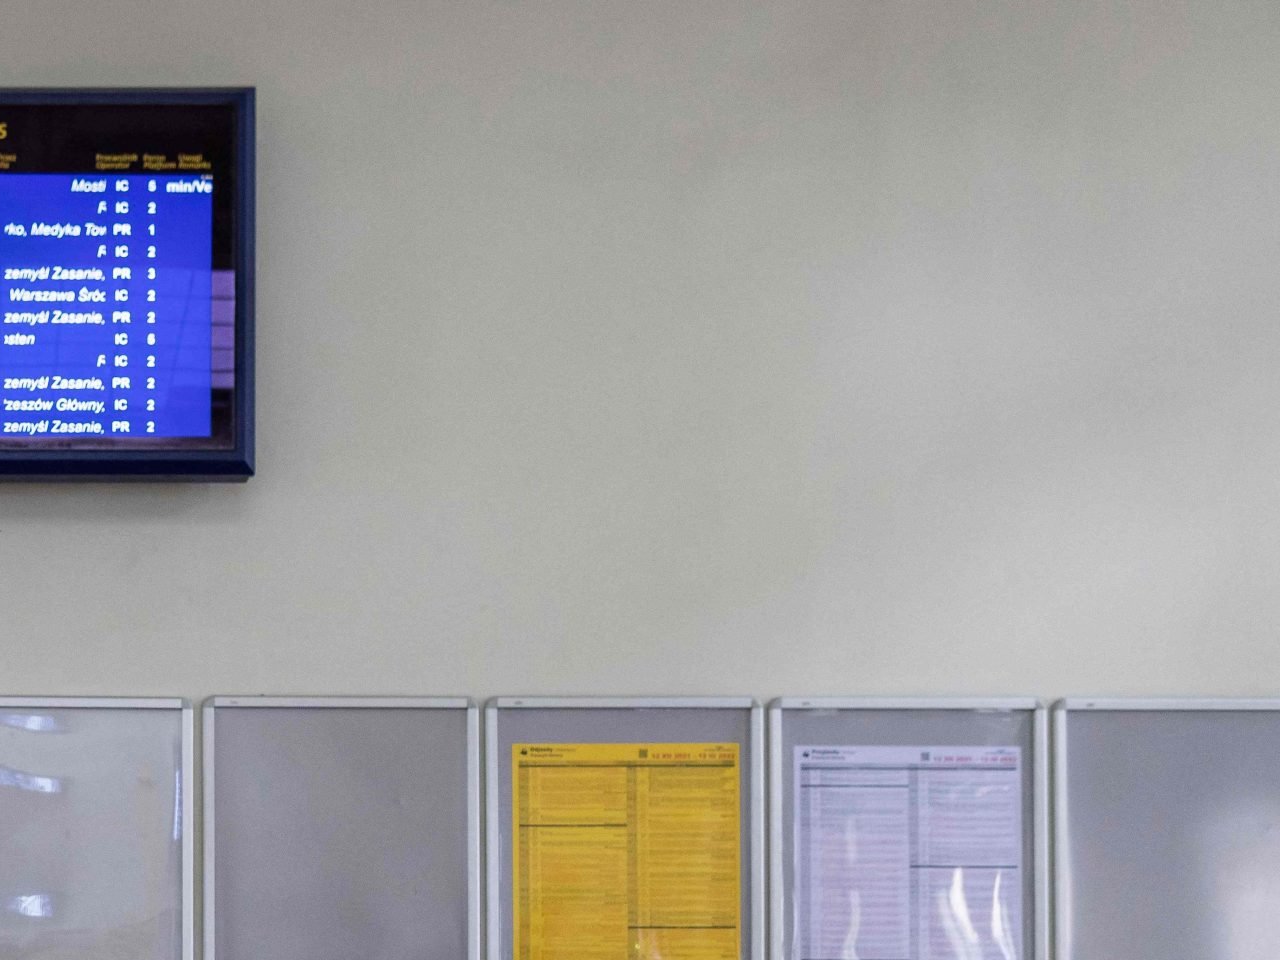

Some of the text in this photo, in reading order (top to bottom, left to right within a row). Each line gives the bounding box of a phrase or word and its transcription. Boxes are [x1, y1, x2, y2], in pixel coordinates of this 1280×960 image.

[115, 179, 129, 192] IC
[115, 201, 129, 214] IC
[147, 201, 157, 214] 2
[30, 222, 81, 239] Medyka
[112, 223, 132, 236] PR
[147, 223, 156, 236] 1
[115, 245, 129, 258] IC
[147, 245, 157, 258] 2
[112, 267, 132, 280] PR
[147, 267, 156, 280] 3
[9, 288, 76, 302] Warszawa
[115, 289, 129, 302] IC
[147, 289, 156, 302] 2
[112, 311, 131, 324] PR
[147, 311, 156, 324] 2
[115, 333, 129, 346] IC
[114, 355, 128, 368] IC
[147, 355, 156, 368] 2
[111, 377, 131, 389] PR
[146, 377, 156, 390] 2
[3, 398, 54, 411] zeszów
[114, 398, 128, 411] IC
[146, 398, 155, 411] 2
[111, 420, 130, 433] PR
[146, 420, 155, 433] 2
